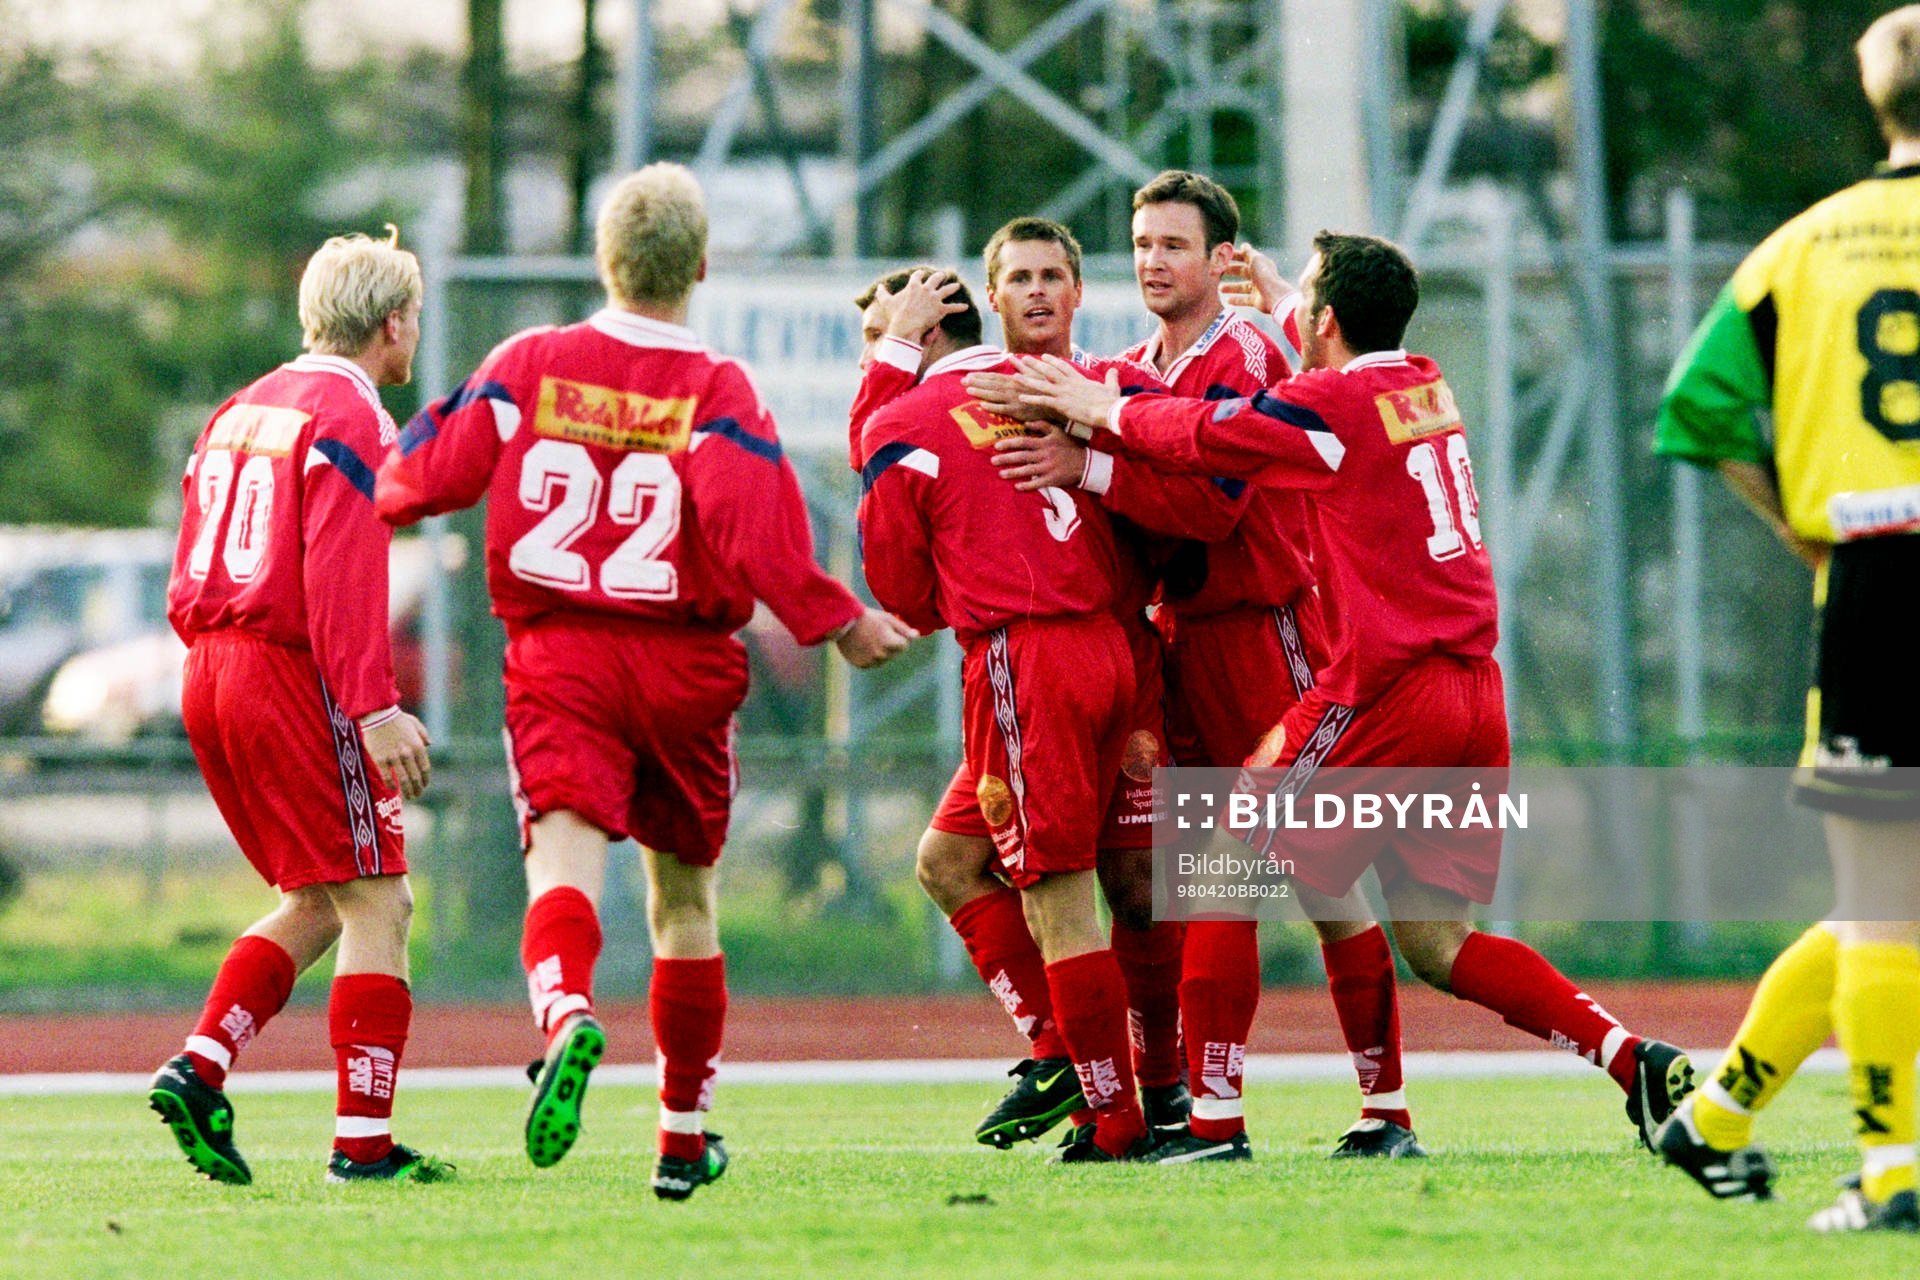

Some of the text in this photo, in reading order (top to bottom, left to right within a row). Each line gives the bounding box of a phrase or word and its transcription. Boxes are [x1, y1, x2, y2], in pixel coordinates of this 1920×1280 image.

[1857, 288, 1920, 443] 8
[509, 439, 681, 601] 22
[1406, 432, 1482, 563] 10
[373, 1058, 393, 1099] INTER
